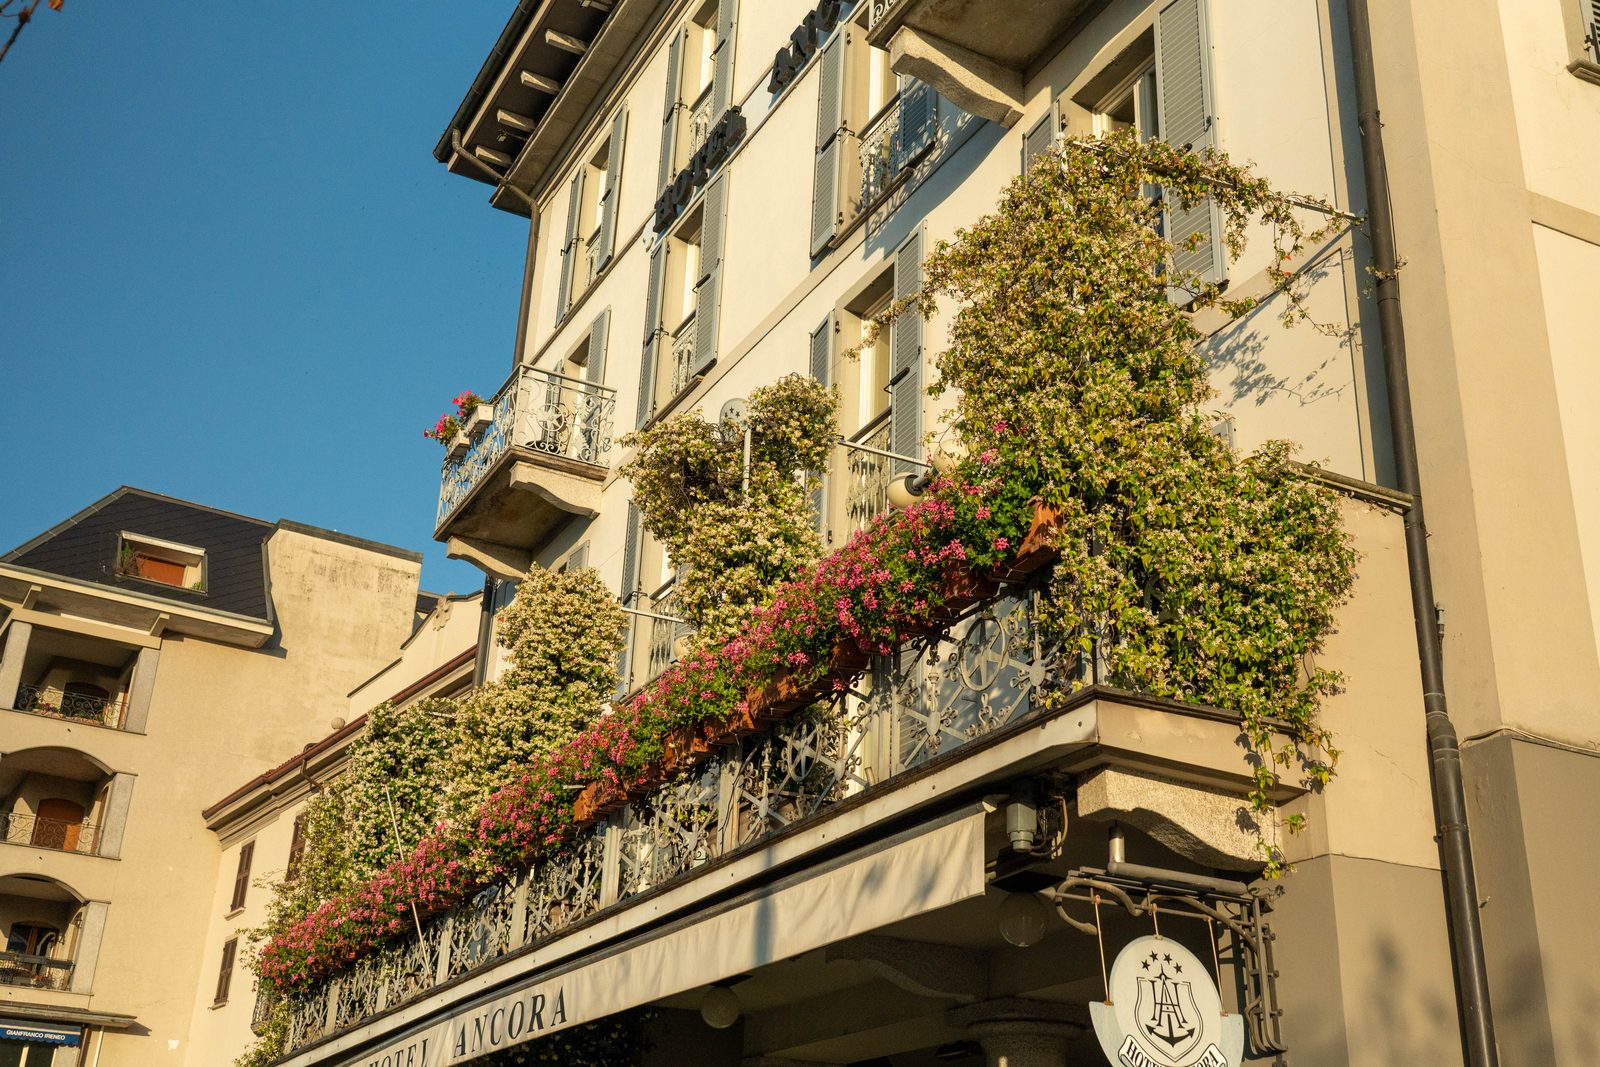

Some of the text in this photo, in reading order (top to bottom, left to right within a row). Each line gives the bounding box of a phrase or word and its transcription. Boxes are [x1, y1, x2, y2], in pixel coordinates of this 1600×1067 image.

[653, 105, 747, 233] HOTEL
[6, 1029, 44, 1039] GIANFRANCO
[452, 985, 568, 1059] ANCORA
